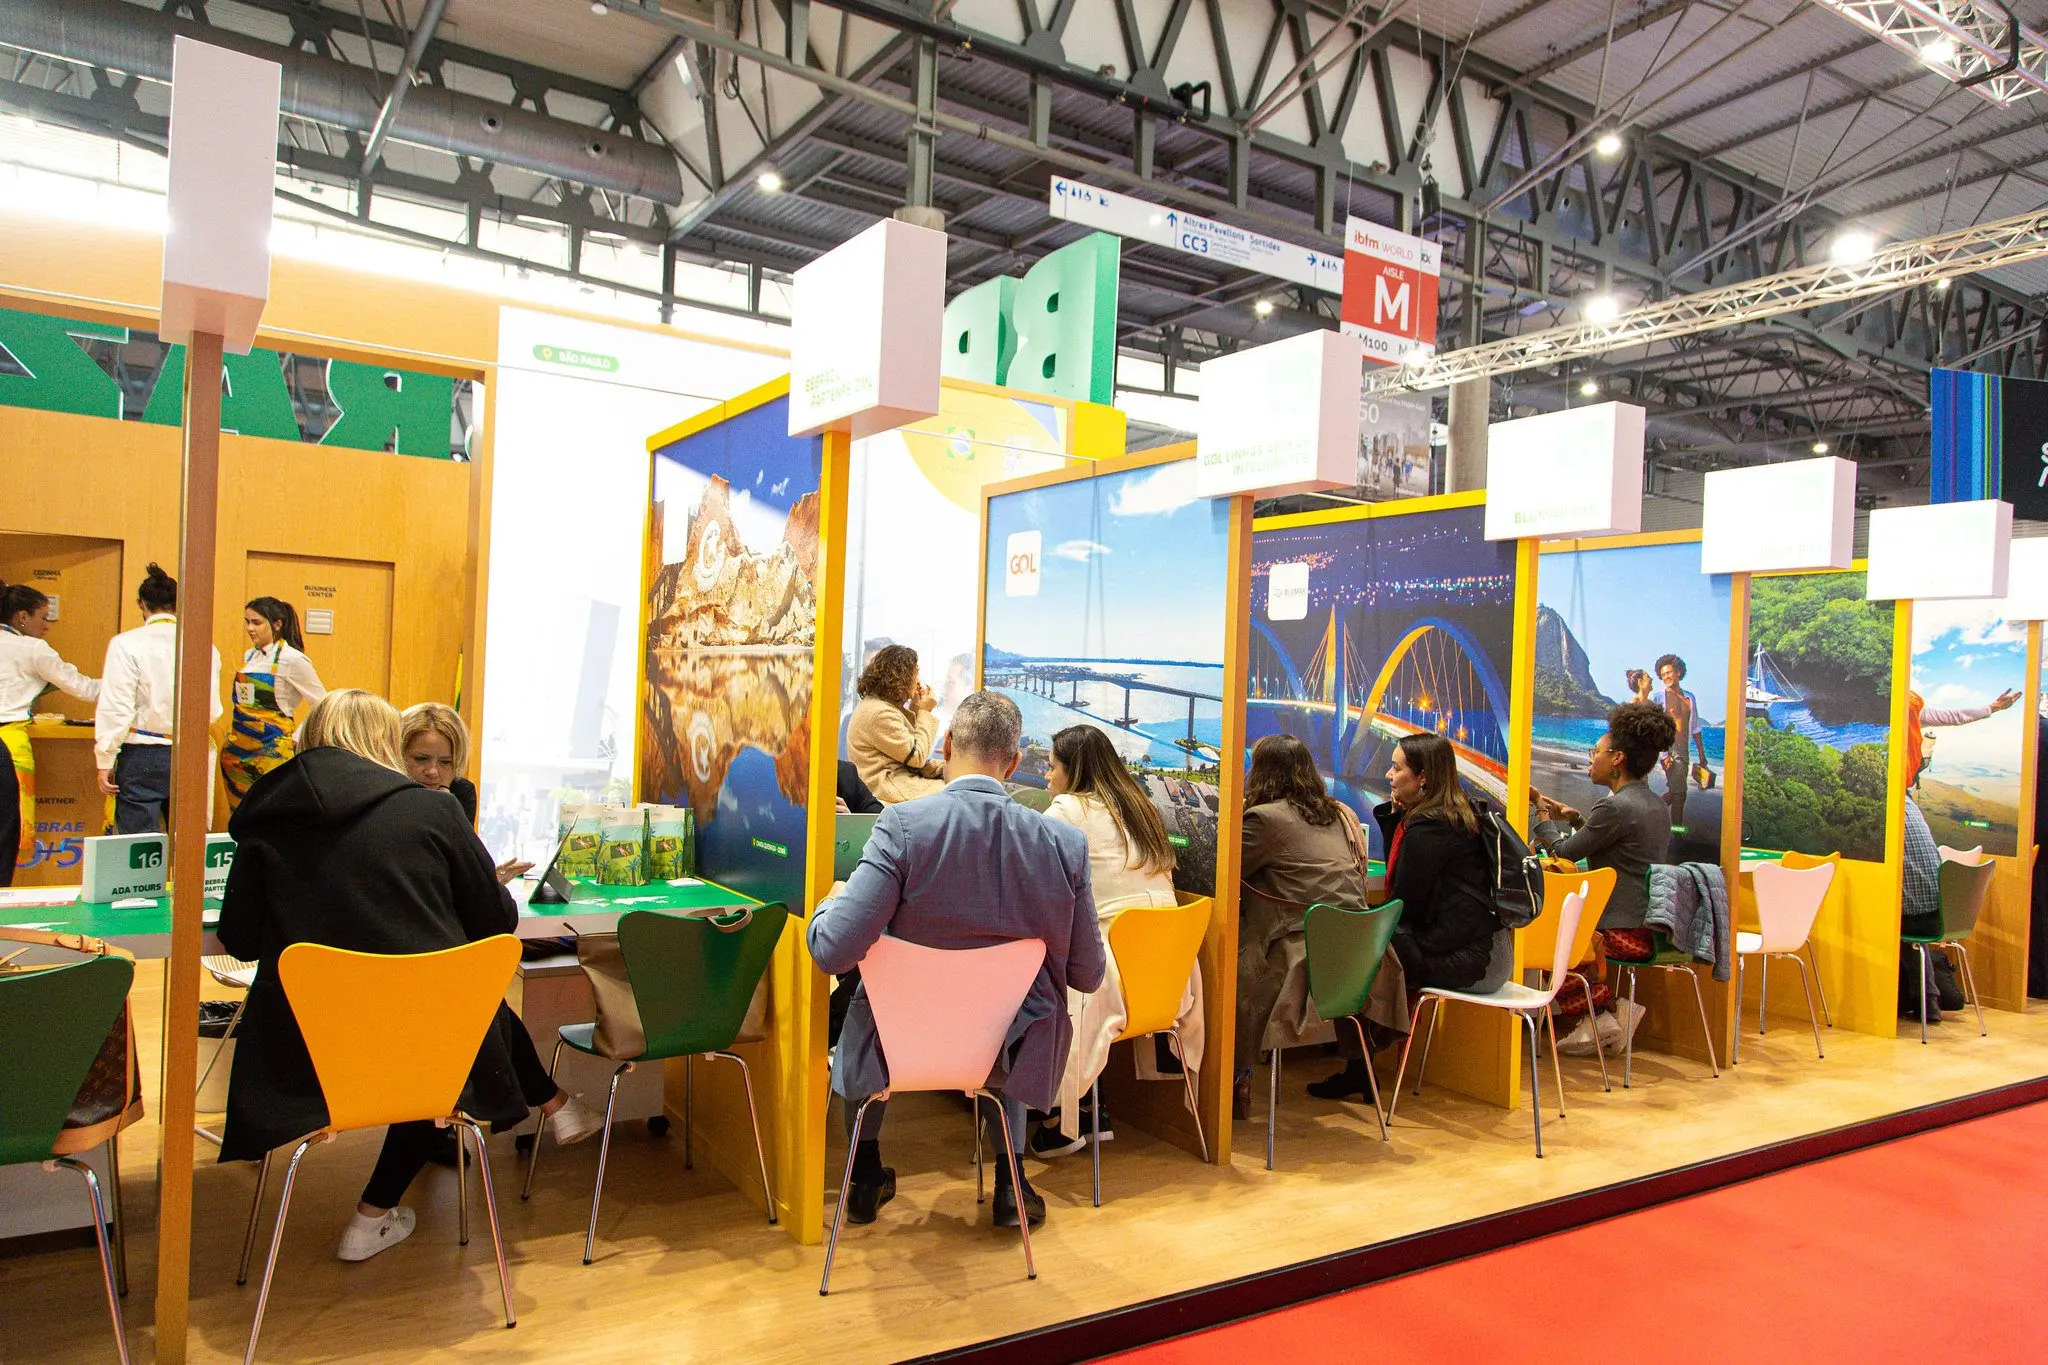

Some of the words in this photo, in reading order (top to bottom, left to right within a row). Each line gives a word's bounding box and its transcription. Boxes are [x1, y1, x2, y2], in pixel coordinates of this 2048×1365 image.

[1183, 215, 1207, 231] Altres
[1208, 221, 1245, 242] Pavellons
[1182, 233, 1208, 253] CC3
[1250, 234, 1281, 252] Sortides
[1354, 230, 1379, 249] ibtm
[1381, 242, 1414, 261] WORLD
[1382, 266, 1405, 281] AISLE
[1373, 273, 1410, 332] M
[33, 569, 61, 577] COZINHA
[1011, 553, 1036, 575] GOL
[138, 852, 160, 868] 16
[213, 852, 234, 868] 15
[111, 884, 131, 896] ADA
[133, 883, 162, 894] TOURS
